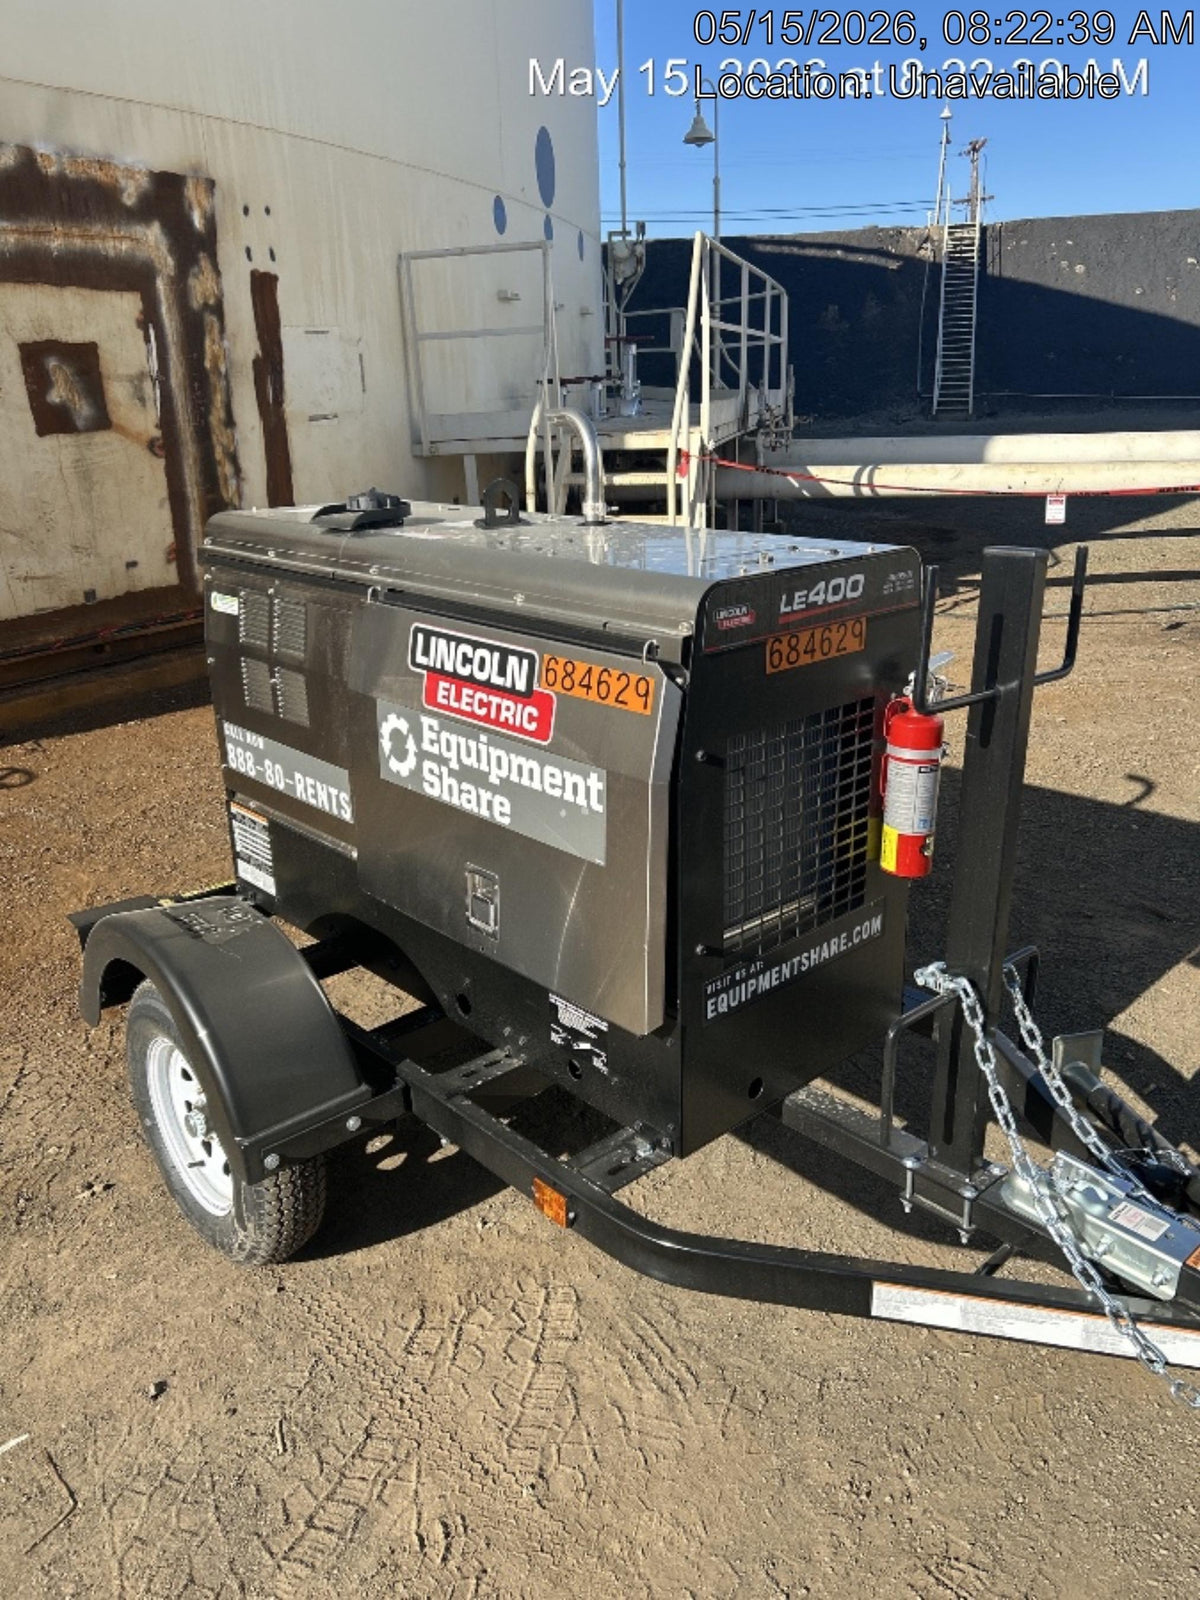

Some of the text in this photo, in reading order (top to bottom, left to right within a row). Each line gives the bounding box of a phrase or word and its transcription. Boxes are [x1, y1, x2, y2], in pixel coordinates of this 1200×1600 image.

[779, 573, 865, 614] LE400
[415, 631, 528, 693] LINCOLN
[769, 619, 864, 670] 684629
[436, 680, 539, 732] ELECTRIC
[544, 656, 651, 711] 684629
[226, 742, 353, 823] 888-80-RENTS
[420, 715, 604, 813] Equipment
[421, 759, 512, 826] Share
[706, 913, 883, 1020] EQUIPMENTSHARE.COM
